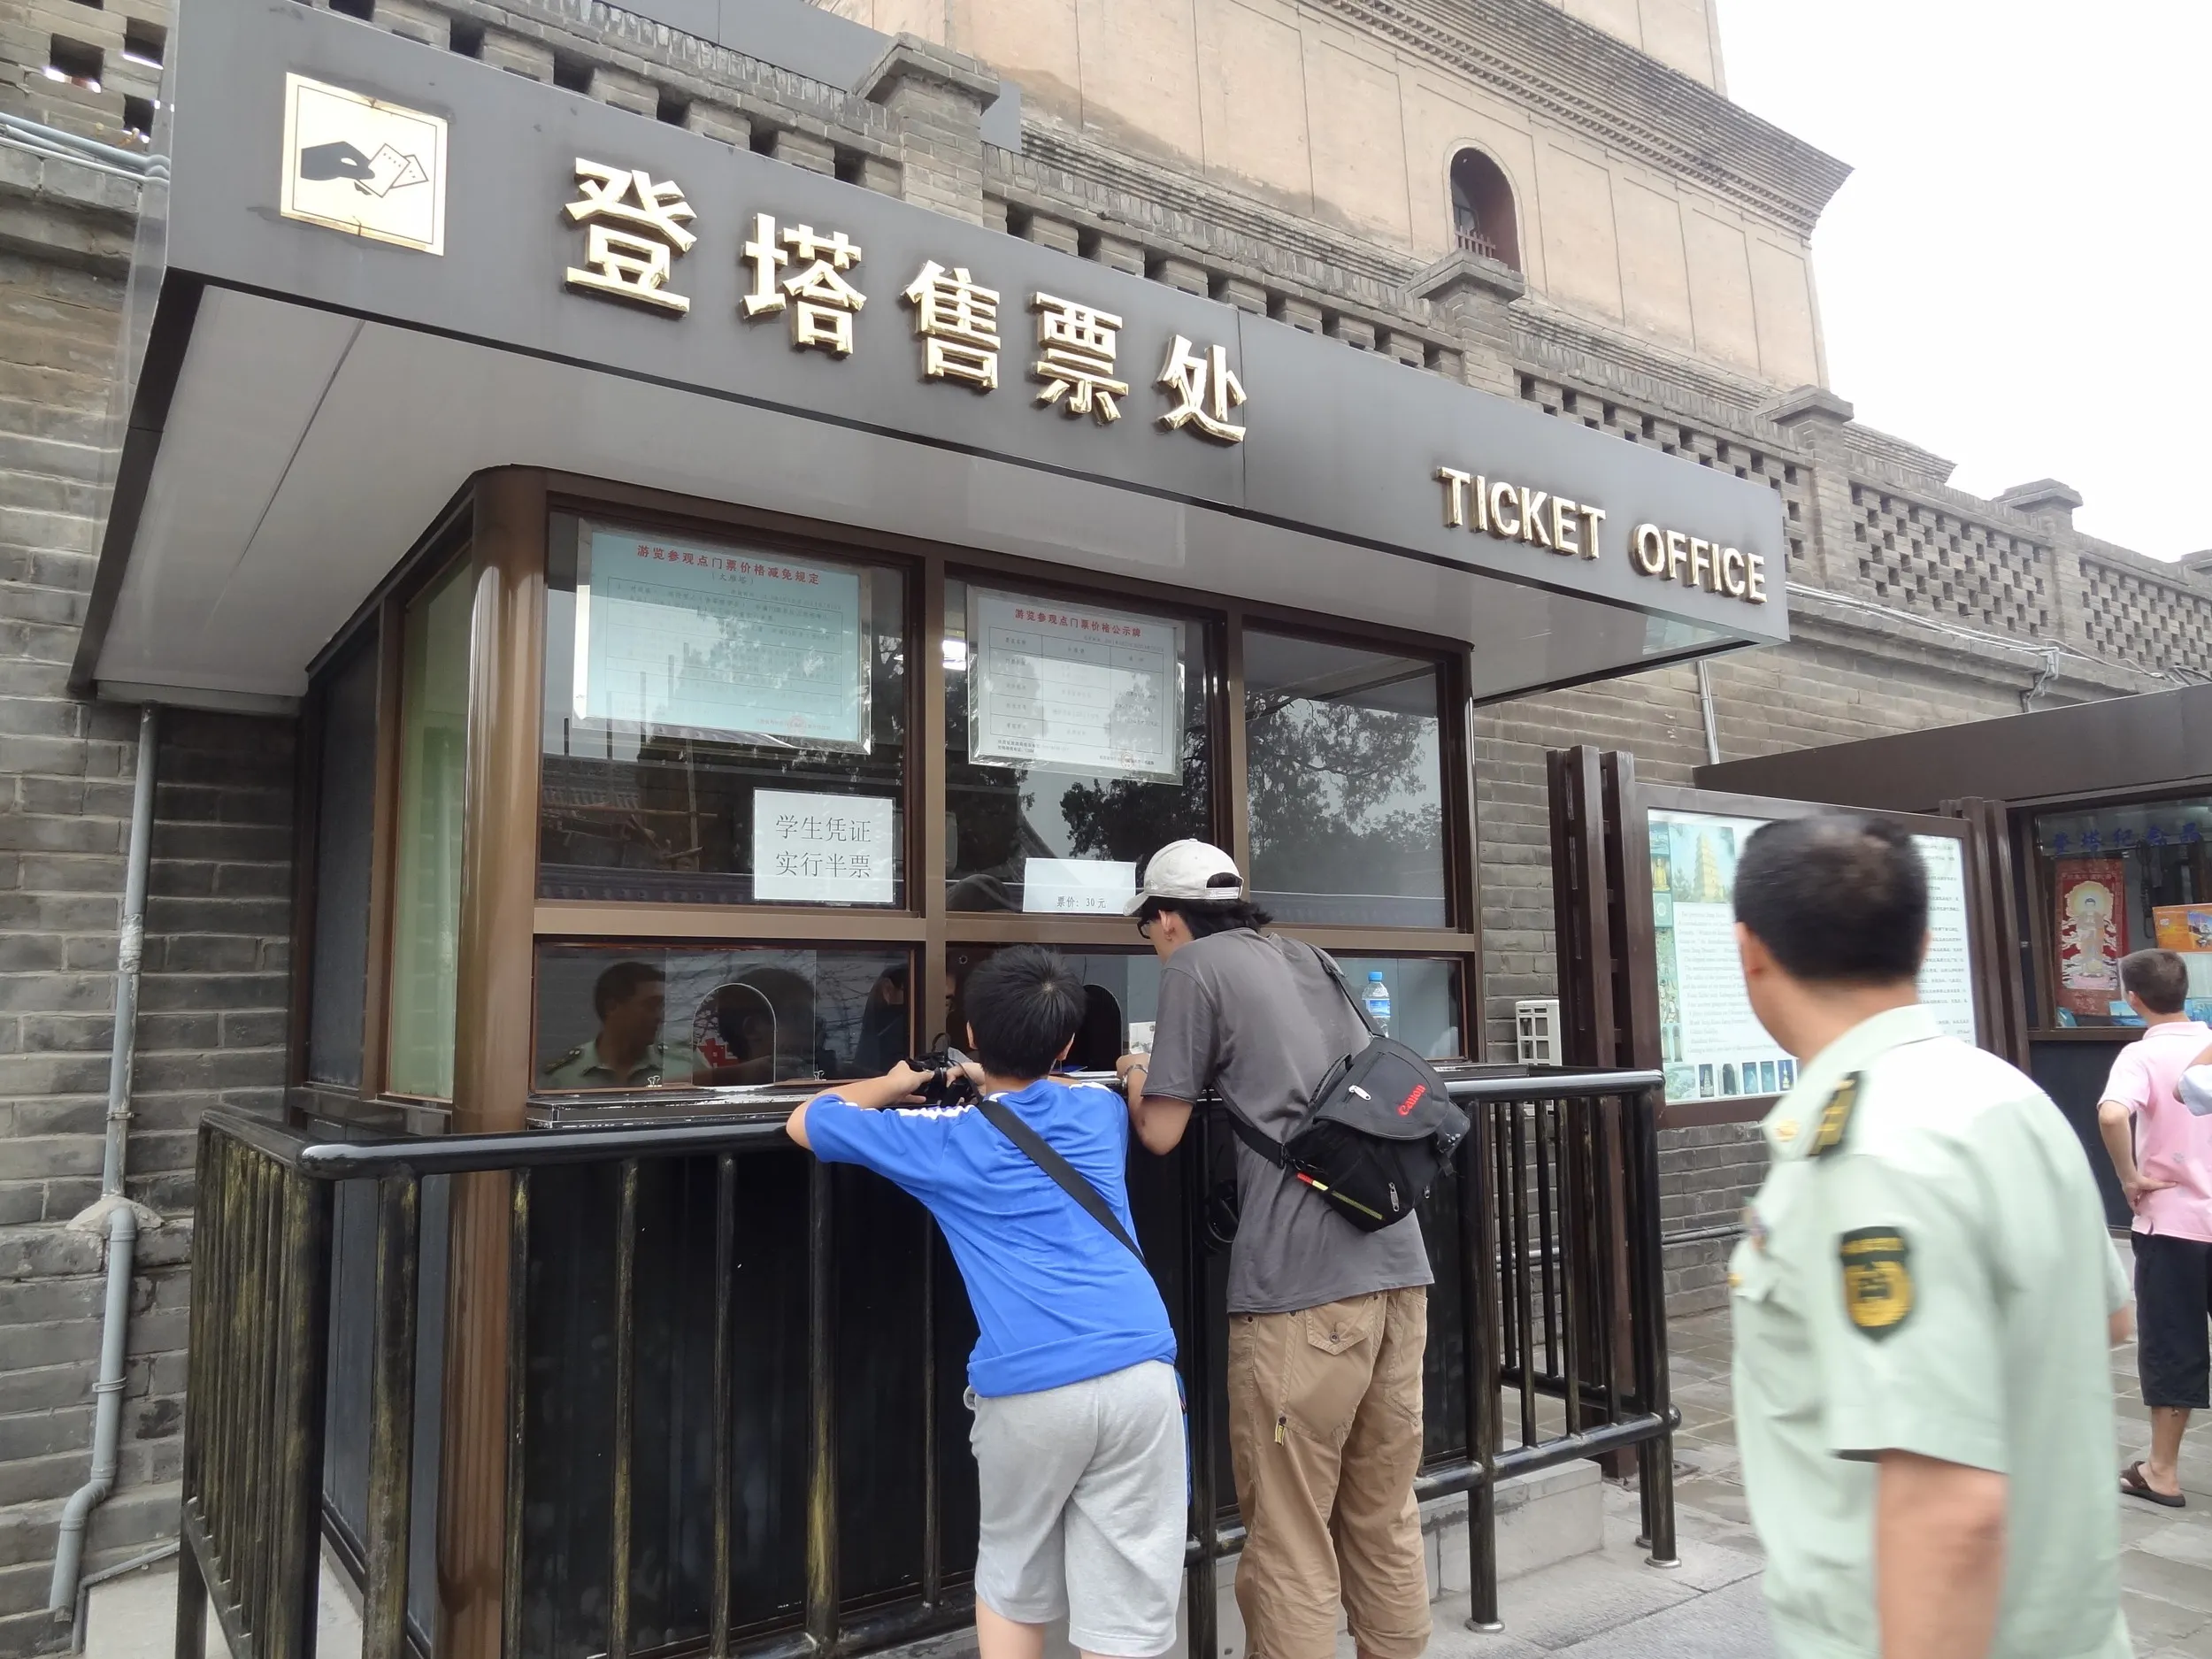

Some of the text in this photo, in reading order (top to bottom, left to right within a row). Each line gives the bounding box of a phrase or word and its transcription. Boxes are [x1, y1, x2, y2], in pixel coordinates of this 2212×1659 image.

[562, 157, 1247, 444] 登塔售票处
[1434, 465, 1768, 604] TICKET OFFICE
[636, 544, 820, 586] 游览参观点门票价格减免规定
[1015, 608, 1141, 638] 游览参观点门票价格公示牌
[775, 814, 872, 842] 学生凭证
[775, 850, 872, 878] 实行半票
[1397, 1084, 1426, 1116] Canon
